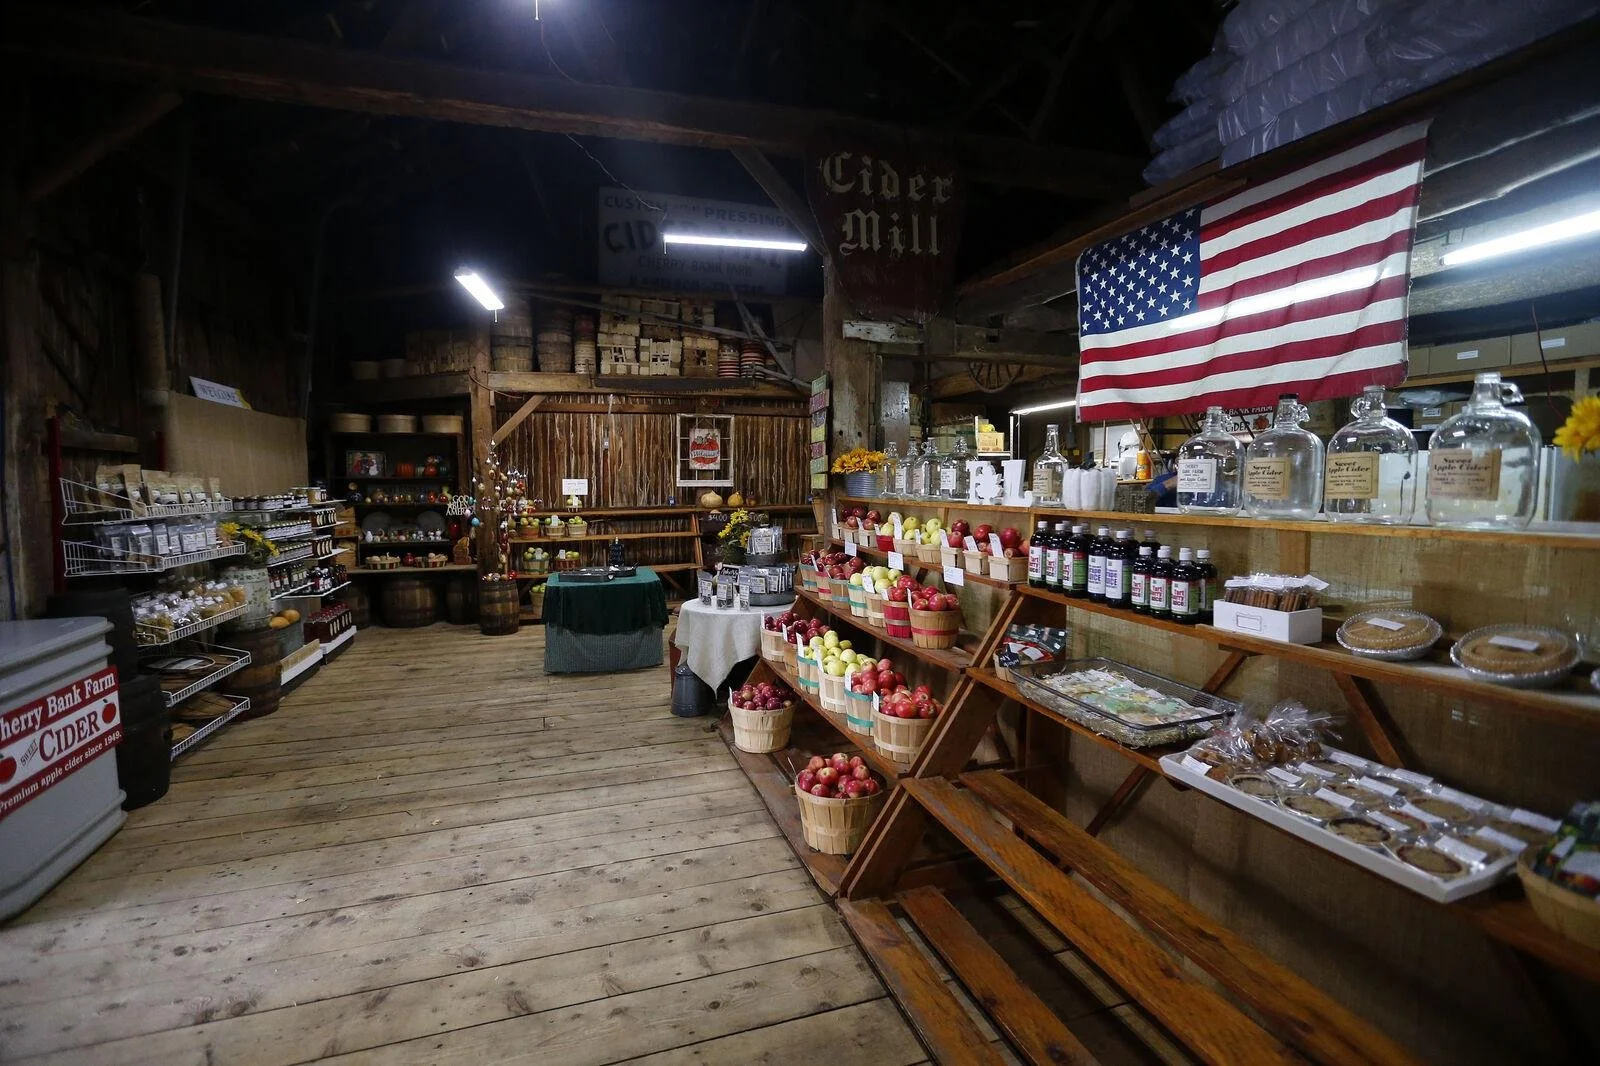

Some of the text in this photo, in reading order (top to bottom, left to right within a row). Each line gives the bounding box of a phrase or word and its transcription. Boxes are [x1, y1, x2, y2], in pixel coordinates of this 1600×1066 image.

[821, 151, 953, 203] Cider
[704, 207, 786, 227] PRESSING
[839, 208, 941, 257] Mill
[638, 256, 685, 270] CHERRY
[0, 673, 116, 740] herry Bank Farm
[20, 739, 38, 767] SWEET
[39, 711, 100, 762] CIDER
[41, 767, 63, 787] apple
[65, 755, 84, 772] cider
[85, 743, 103, 759] since
[104, 731, 122, 747] 1949.
